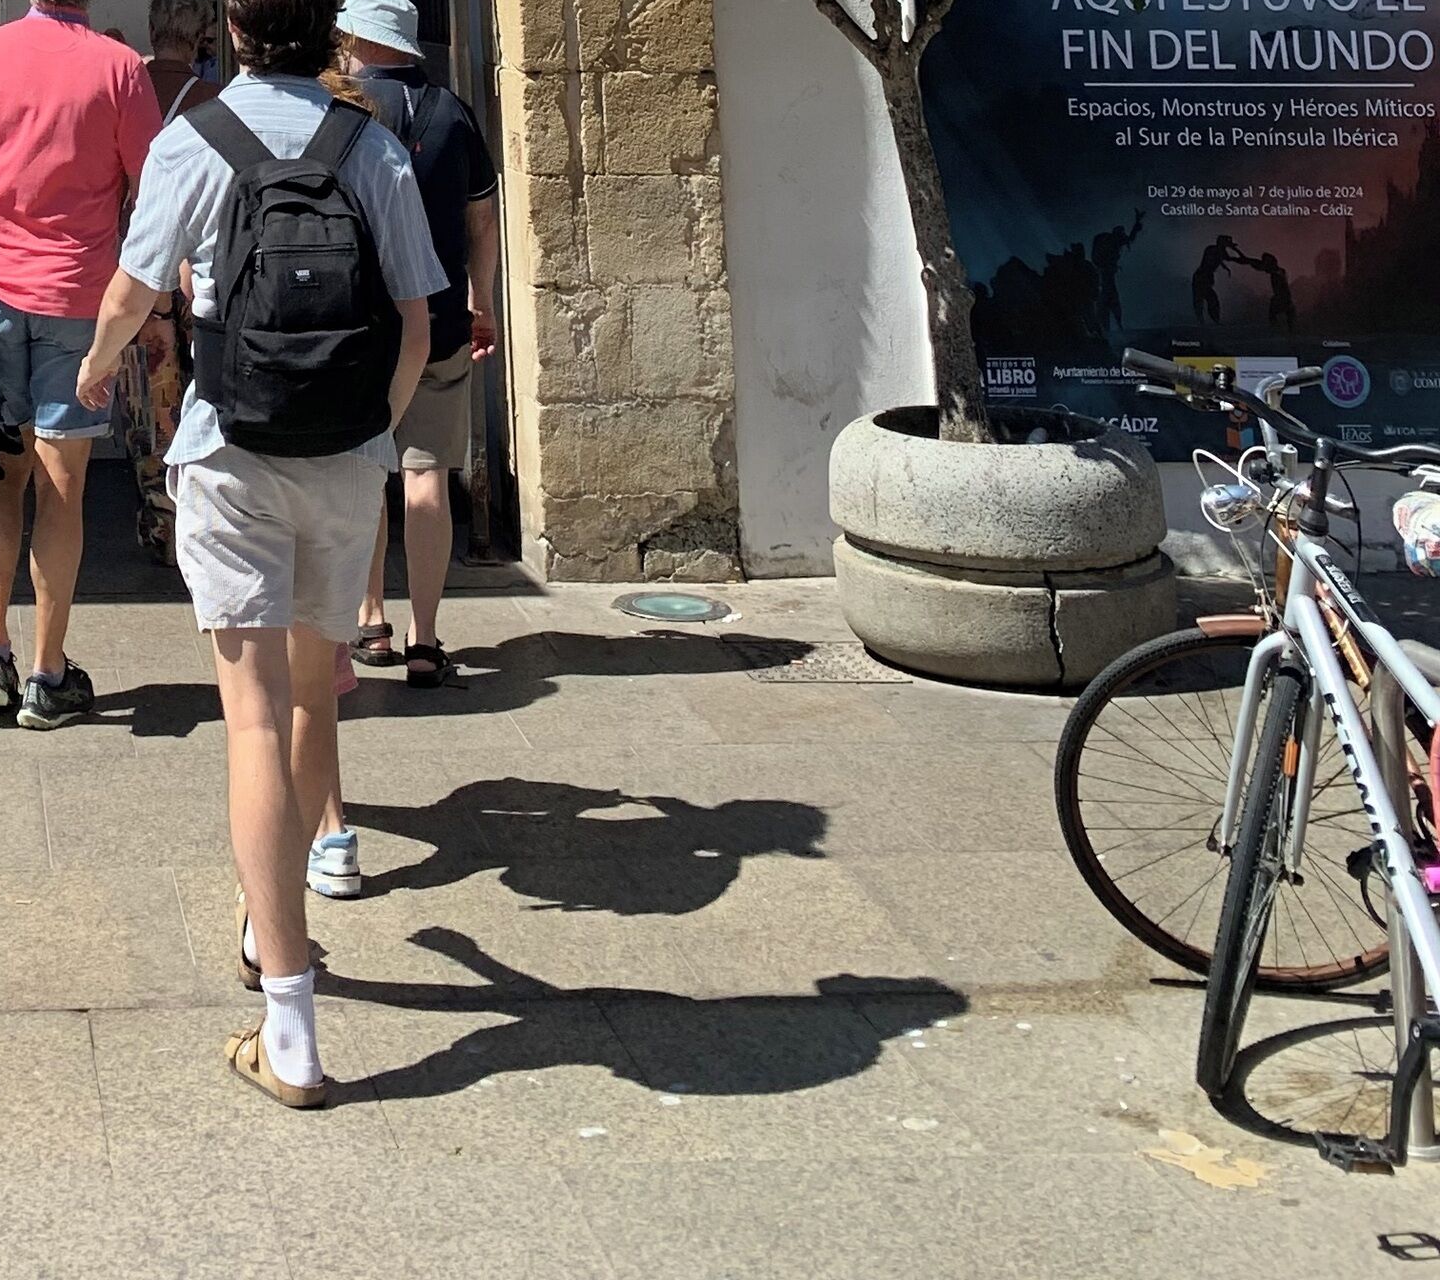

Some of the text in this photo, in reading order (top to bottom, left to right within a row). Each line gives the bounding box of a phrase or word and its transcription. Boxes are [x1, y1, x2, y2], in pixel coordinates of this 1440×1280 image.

[1062, 29, 1435, 71] FIN DEL MUNDO
[1067, 98, 1436, 121] Espacios, Monstruos y Héroes Míticos
[1115, 126, 1399, 146] al Sur de la Península Ibérica
[1148, 185, 1363, 201] Del 29 de mayo al 7 de julio de 2024
[1161, 203, 1205, 216] Castillo
[1207, 203, 1224, 216] de
[1225, 203, 1260, 216] Santa
[1261, 203, 1311, 216] Catalina
[1320, 203, 1354, 216] Cádiz
[986, 360, 1035, 369] amigos del
[1053, 366, 1109, 379] Ayuntamiento
[1110, 366, 1121, 377] de
[987, 369, 1036, 385] LIBRO
